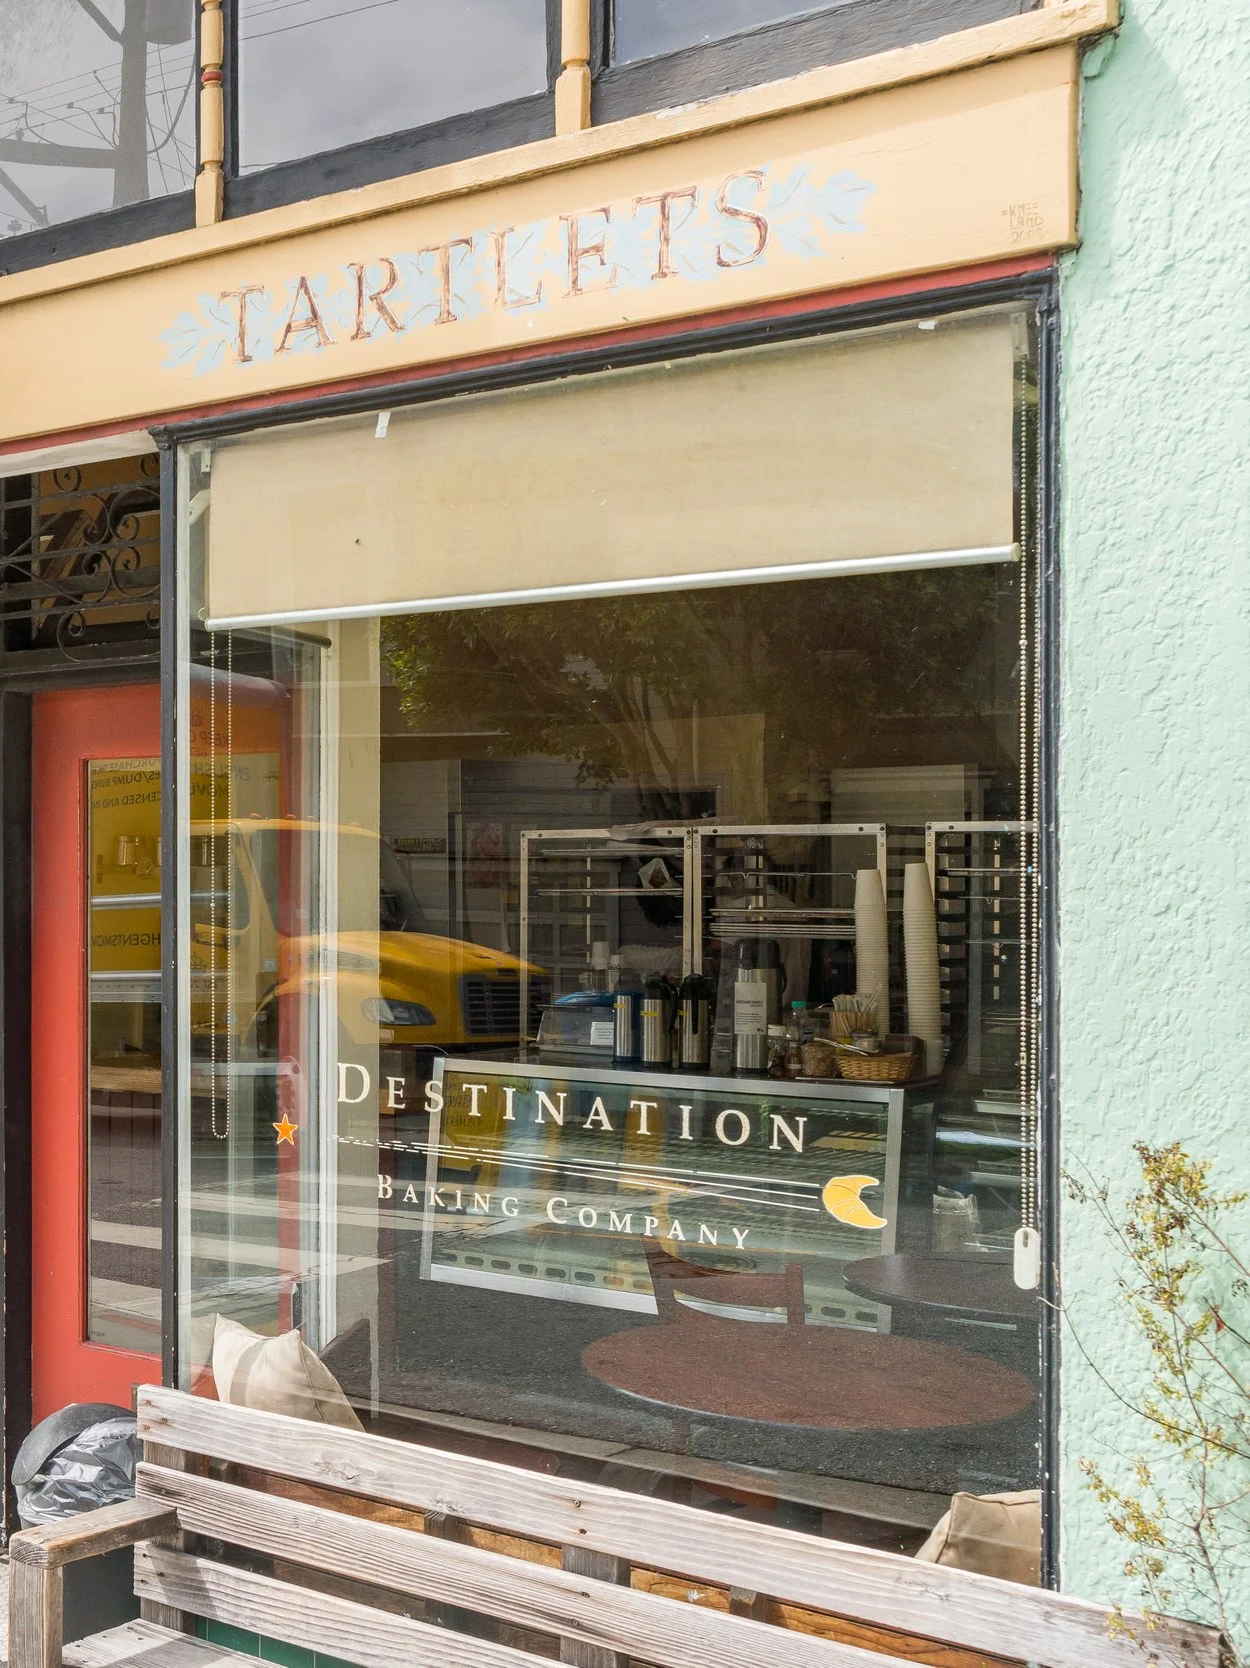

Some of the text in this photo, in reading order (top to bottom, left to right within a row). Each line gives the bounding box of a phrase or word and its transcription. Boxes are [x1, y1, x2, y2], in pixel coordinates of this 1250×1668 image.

[219, 169, 770, 364] TARTLETS
[337, 1060, 809, 1153] DESTINATION
[377, 1174, 751, 1251] BAKING COMPANY
